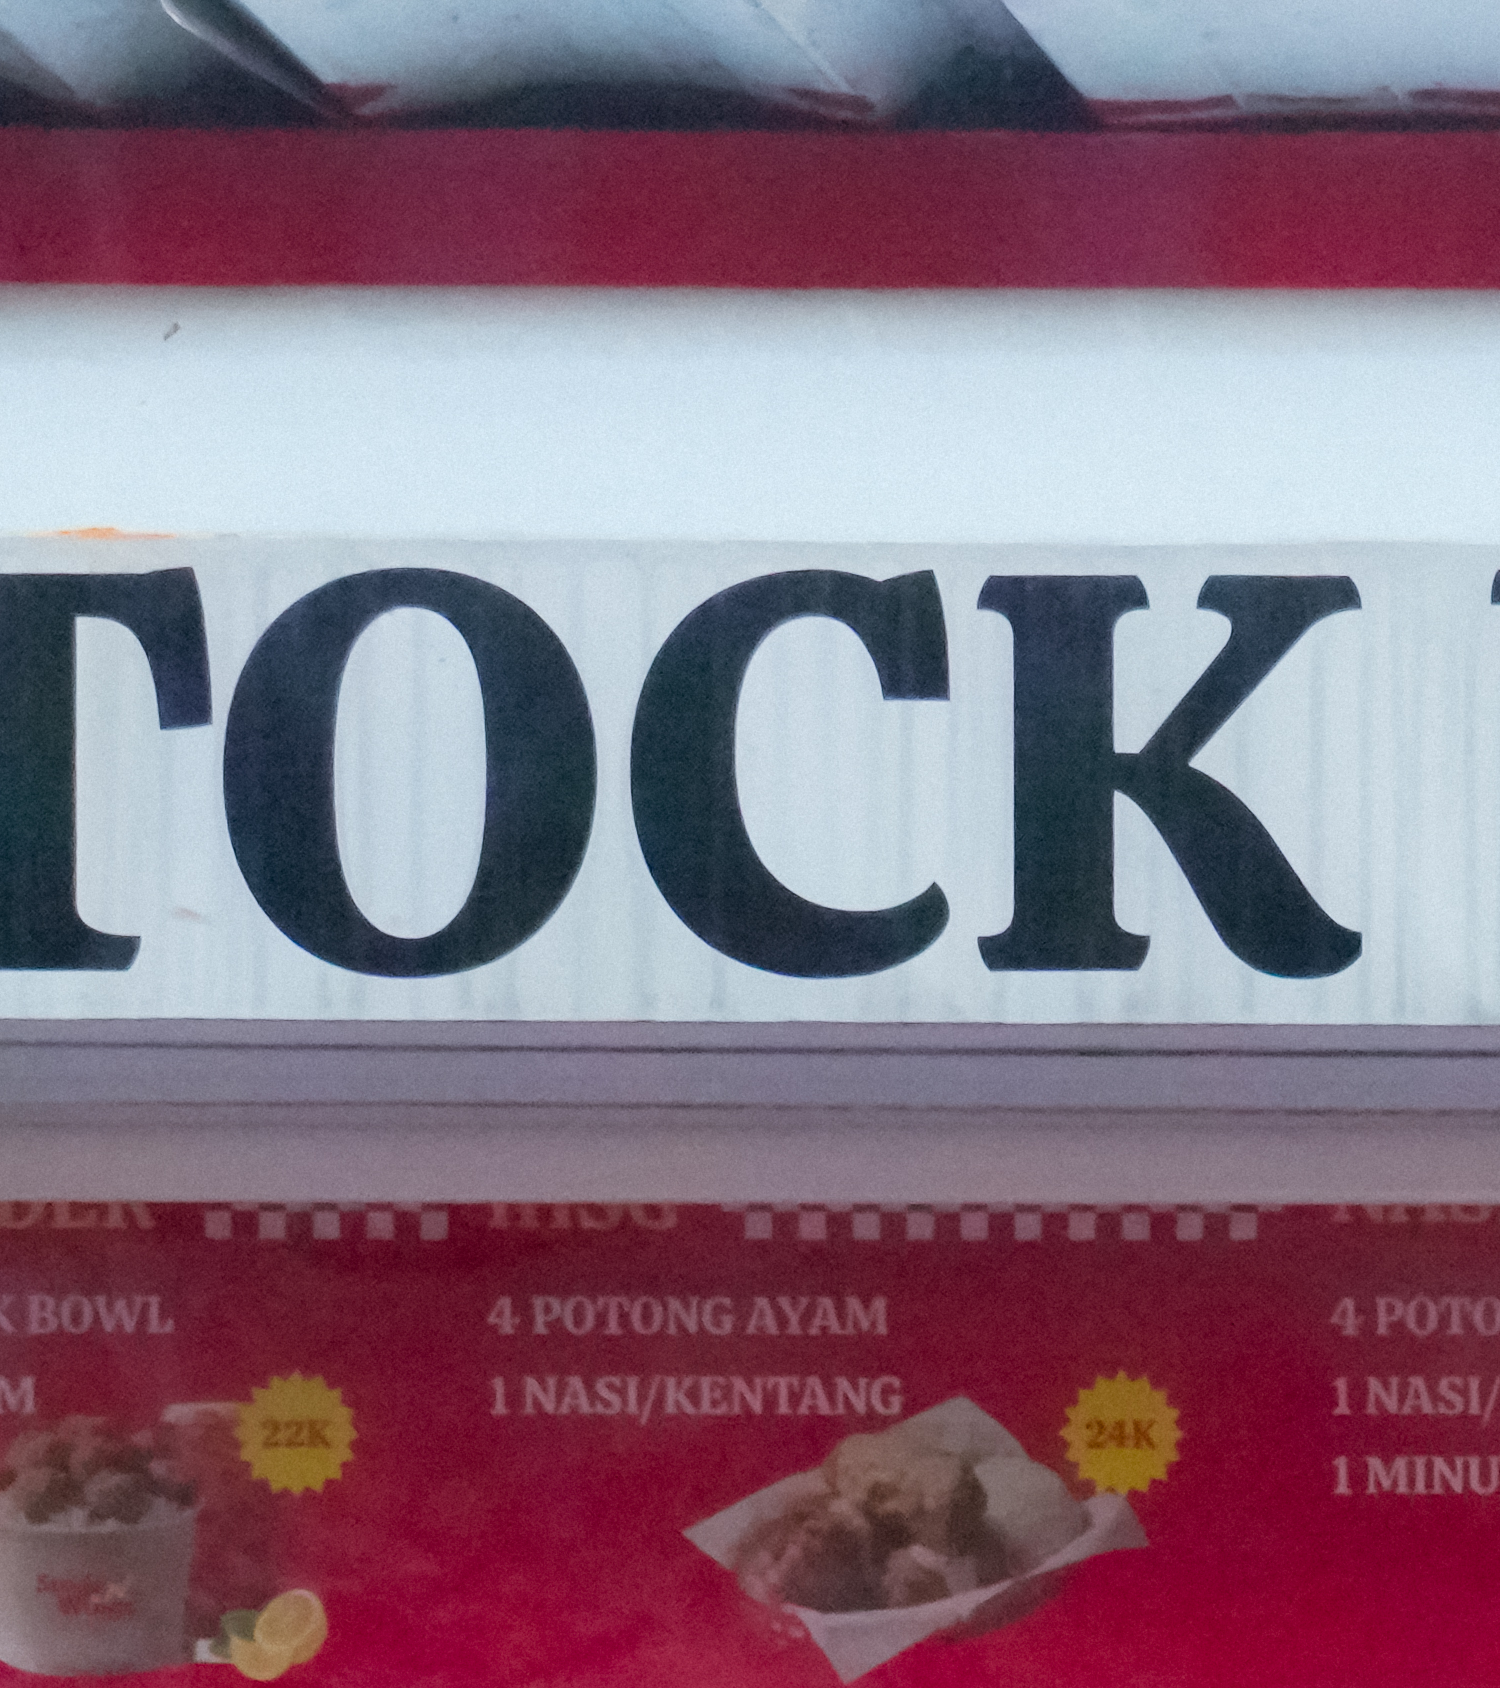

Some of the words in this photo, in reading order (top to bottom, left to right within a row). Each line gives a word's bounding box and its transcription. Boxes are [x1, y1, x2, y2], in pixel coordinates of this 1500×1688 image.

[28, 1296, 174, 1334] BOWL
[487, 1297, 520, 1335] 4
[532, 1296, 733, 1336] POTONG
[745, 1296, 888, 1335] AYAM
[1330, 1297, 1365, 1336] 4
[490, 1376, 510, 1414] 1
[522, 1376, 902, 1424] NASI/KENTANG
[1332, 1377, 1351, 1415] 1
[261, 1420, 332, 1448] 22K
[1086, 1419, 1156, 1450] 24K
[1332, 1457, 1351, 1494] 1
